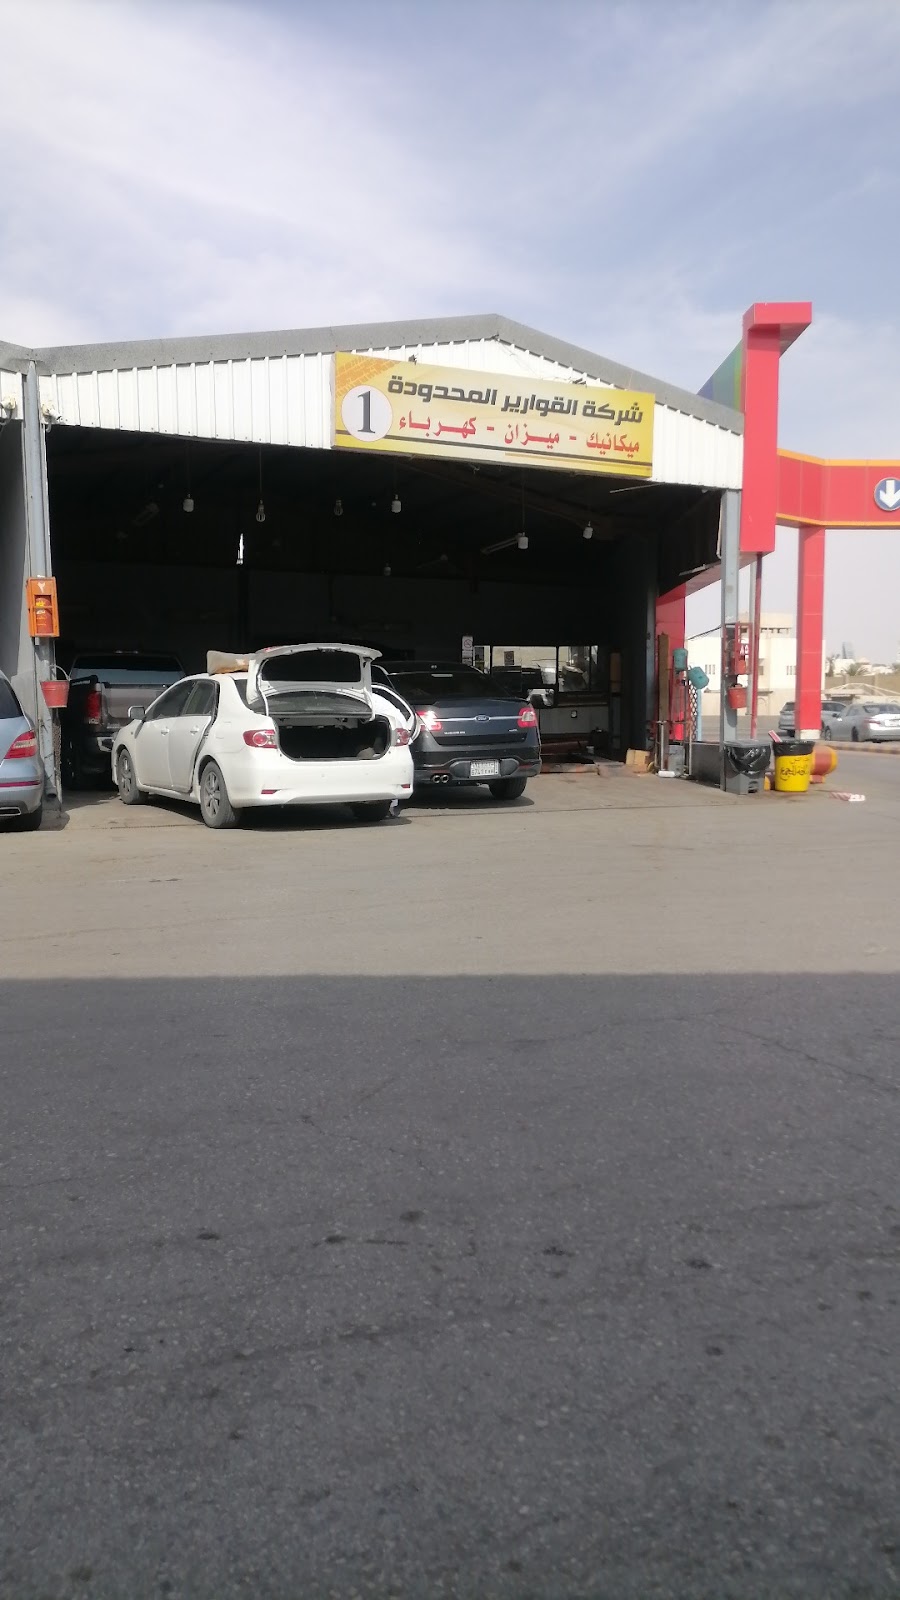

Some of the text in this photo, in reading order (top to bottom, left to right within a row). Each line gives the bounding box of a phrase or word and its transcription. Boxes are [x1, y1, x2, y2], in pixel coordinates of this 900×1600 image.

[357, 390, 376, 434] 1
[387, 375, 643, 426] شركة القوارير المحدودة
[399, 410, 476, 439] كهرباء
[504, 423, 560, 449] ميزان
[586, 432, 640, 458] ميكانيك
